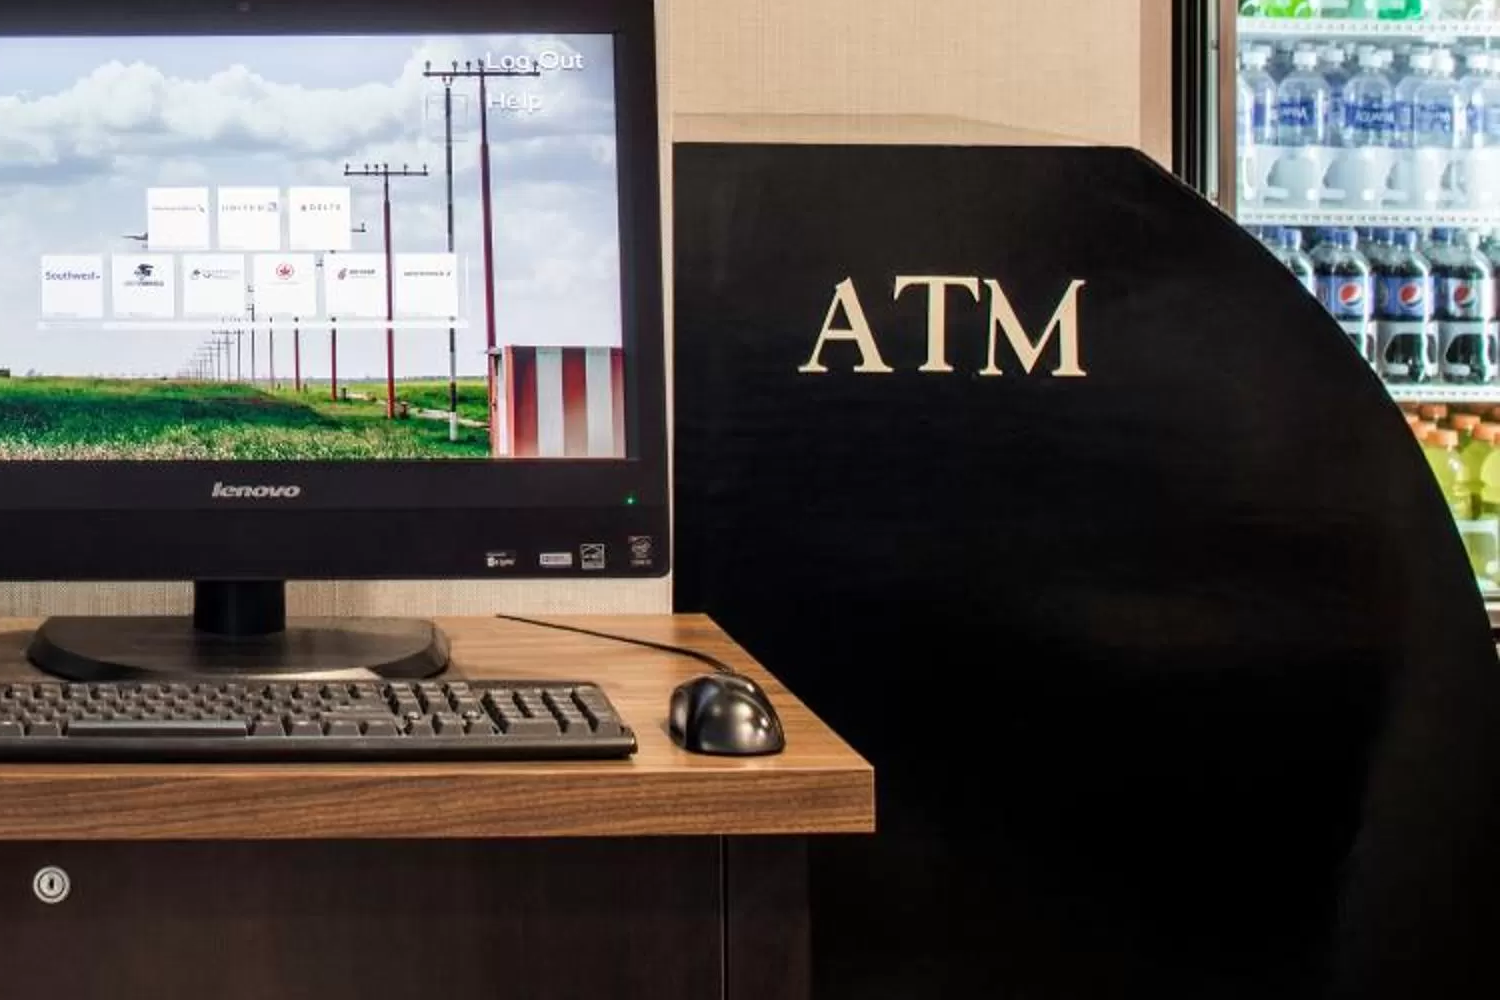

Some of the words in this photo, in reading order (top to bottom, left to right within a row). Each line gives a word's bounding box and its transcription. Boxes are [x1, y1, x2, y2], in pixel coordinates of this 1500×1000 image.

[485, 51, 531, 71] Log
[539, 50, 584, 70] Out
[486, 90, 543, 113] Help
[45, 270, 95, 281] Southwest
[798, 275, 1087, 377] ATM
[211, 481, 301, 498] lenovo
